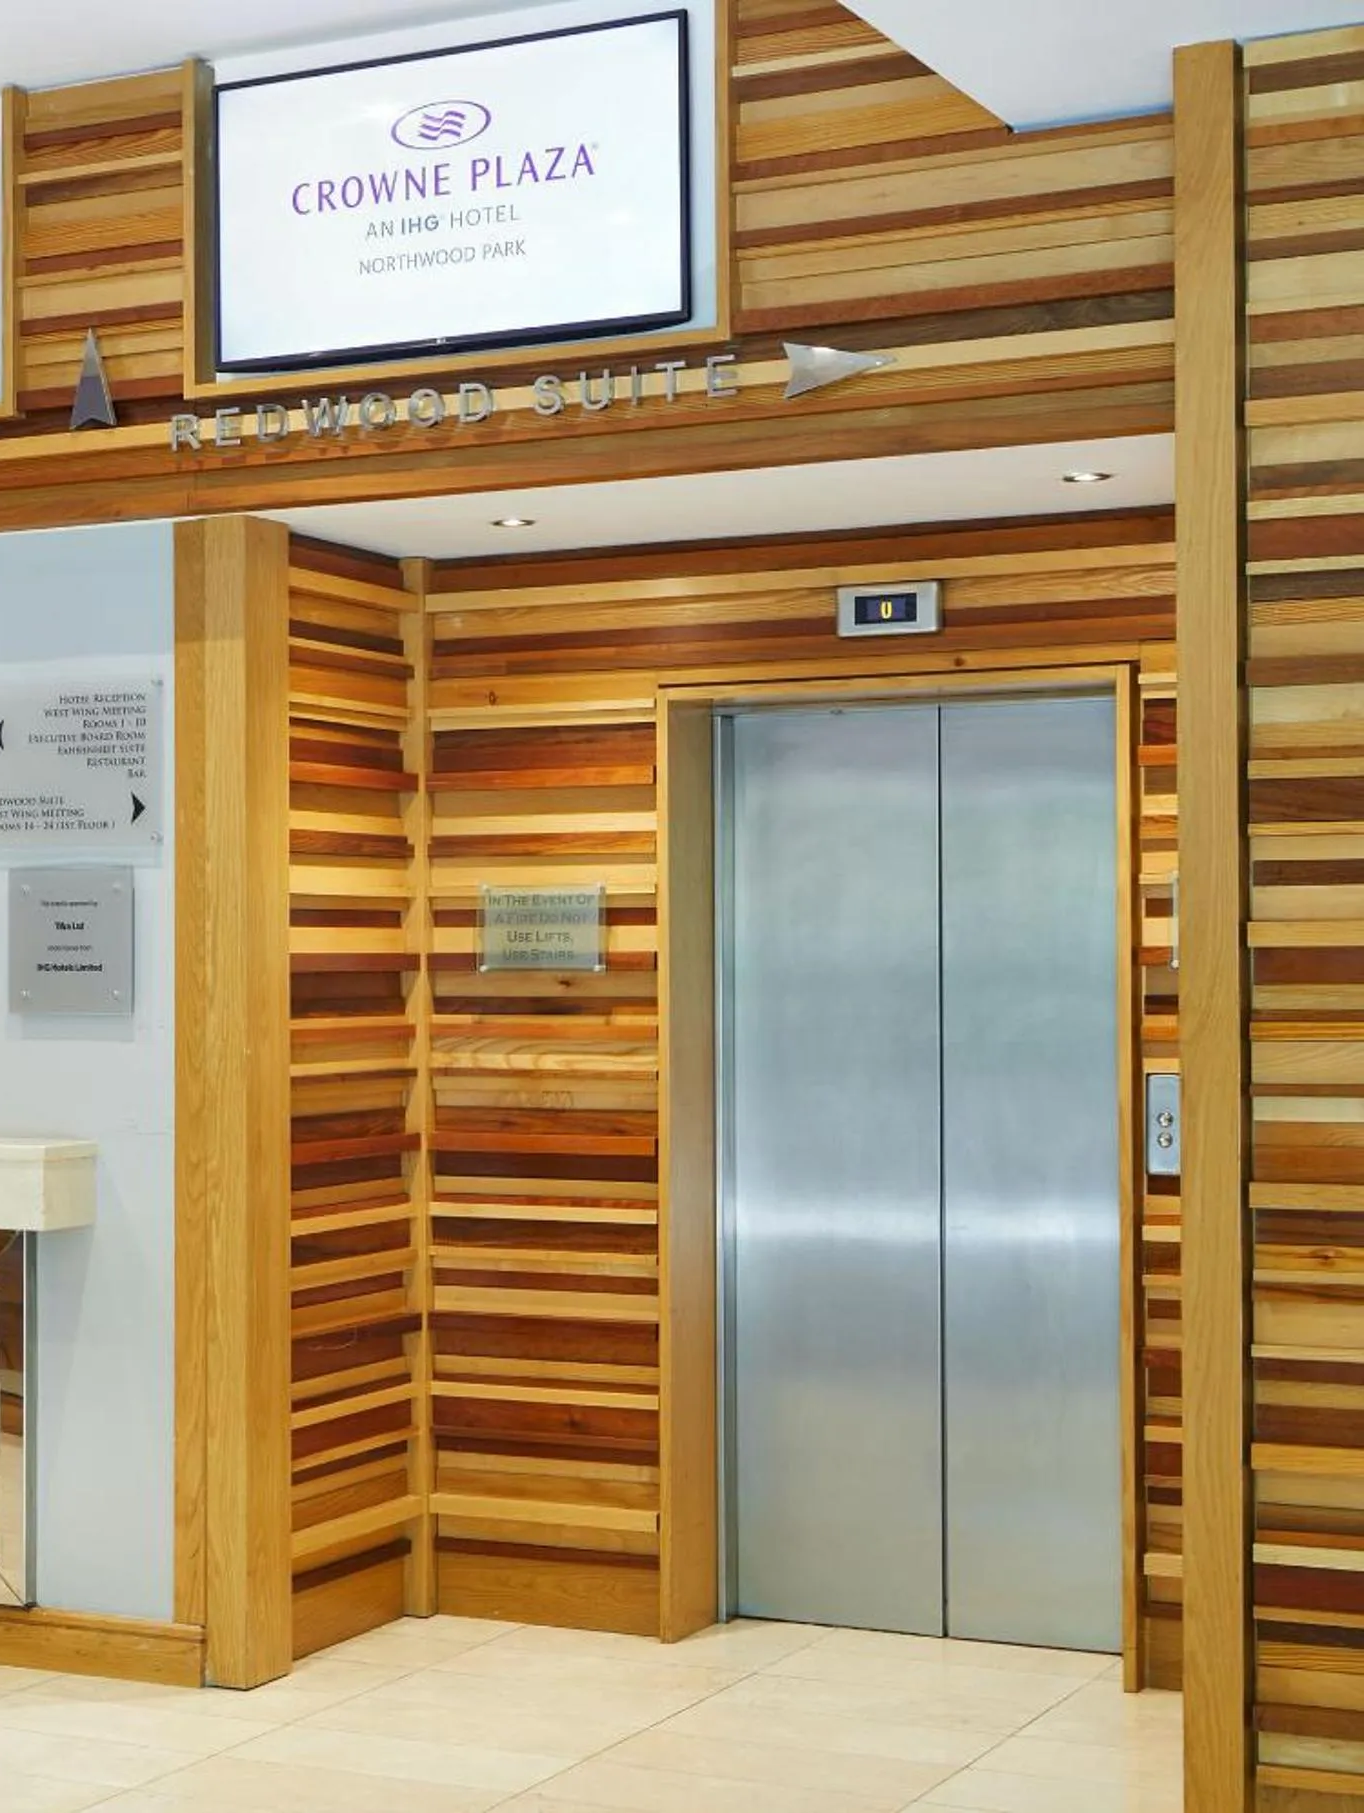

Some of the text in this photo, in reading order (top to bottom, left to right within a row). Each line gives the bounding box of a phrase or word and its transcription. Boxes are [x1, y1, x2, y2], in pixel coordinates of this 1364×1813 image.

[292, 143, 597, 216] CROWNE PLAZA
[366, 204, 522, 240] AN IHG HOTEL
[359, 239, 527, 276] NORTHWOOD PARK
[169, 354, 737, 452] REDWOOD SUITE
[59, 693, 145, 704] HOTEL RECEPTION
[44, 705, 146, 718] WEST WING MEETING
[83, 719, 118, 729] ROOMS
[28, 730, 146, 743] EXECUTIVE BOARD ROOM
[86, 756, 146, 767] RESTAURANT
[11, 809, 38, 818] WING
[41, 808, 85, 818] MEETING
[488, 893, 501, 905] IN
[503, 893, 527, 906] THE
[532, 893, 572, 905] EVENT
[507, 930, 533, 943] USE
